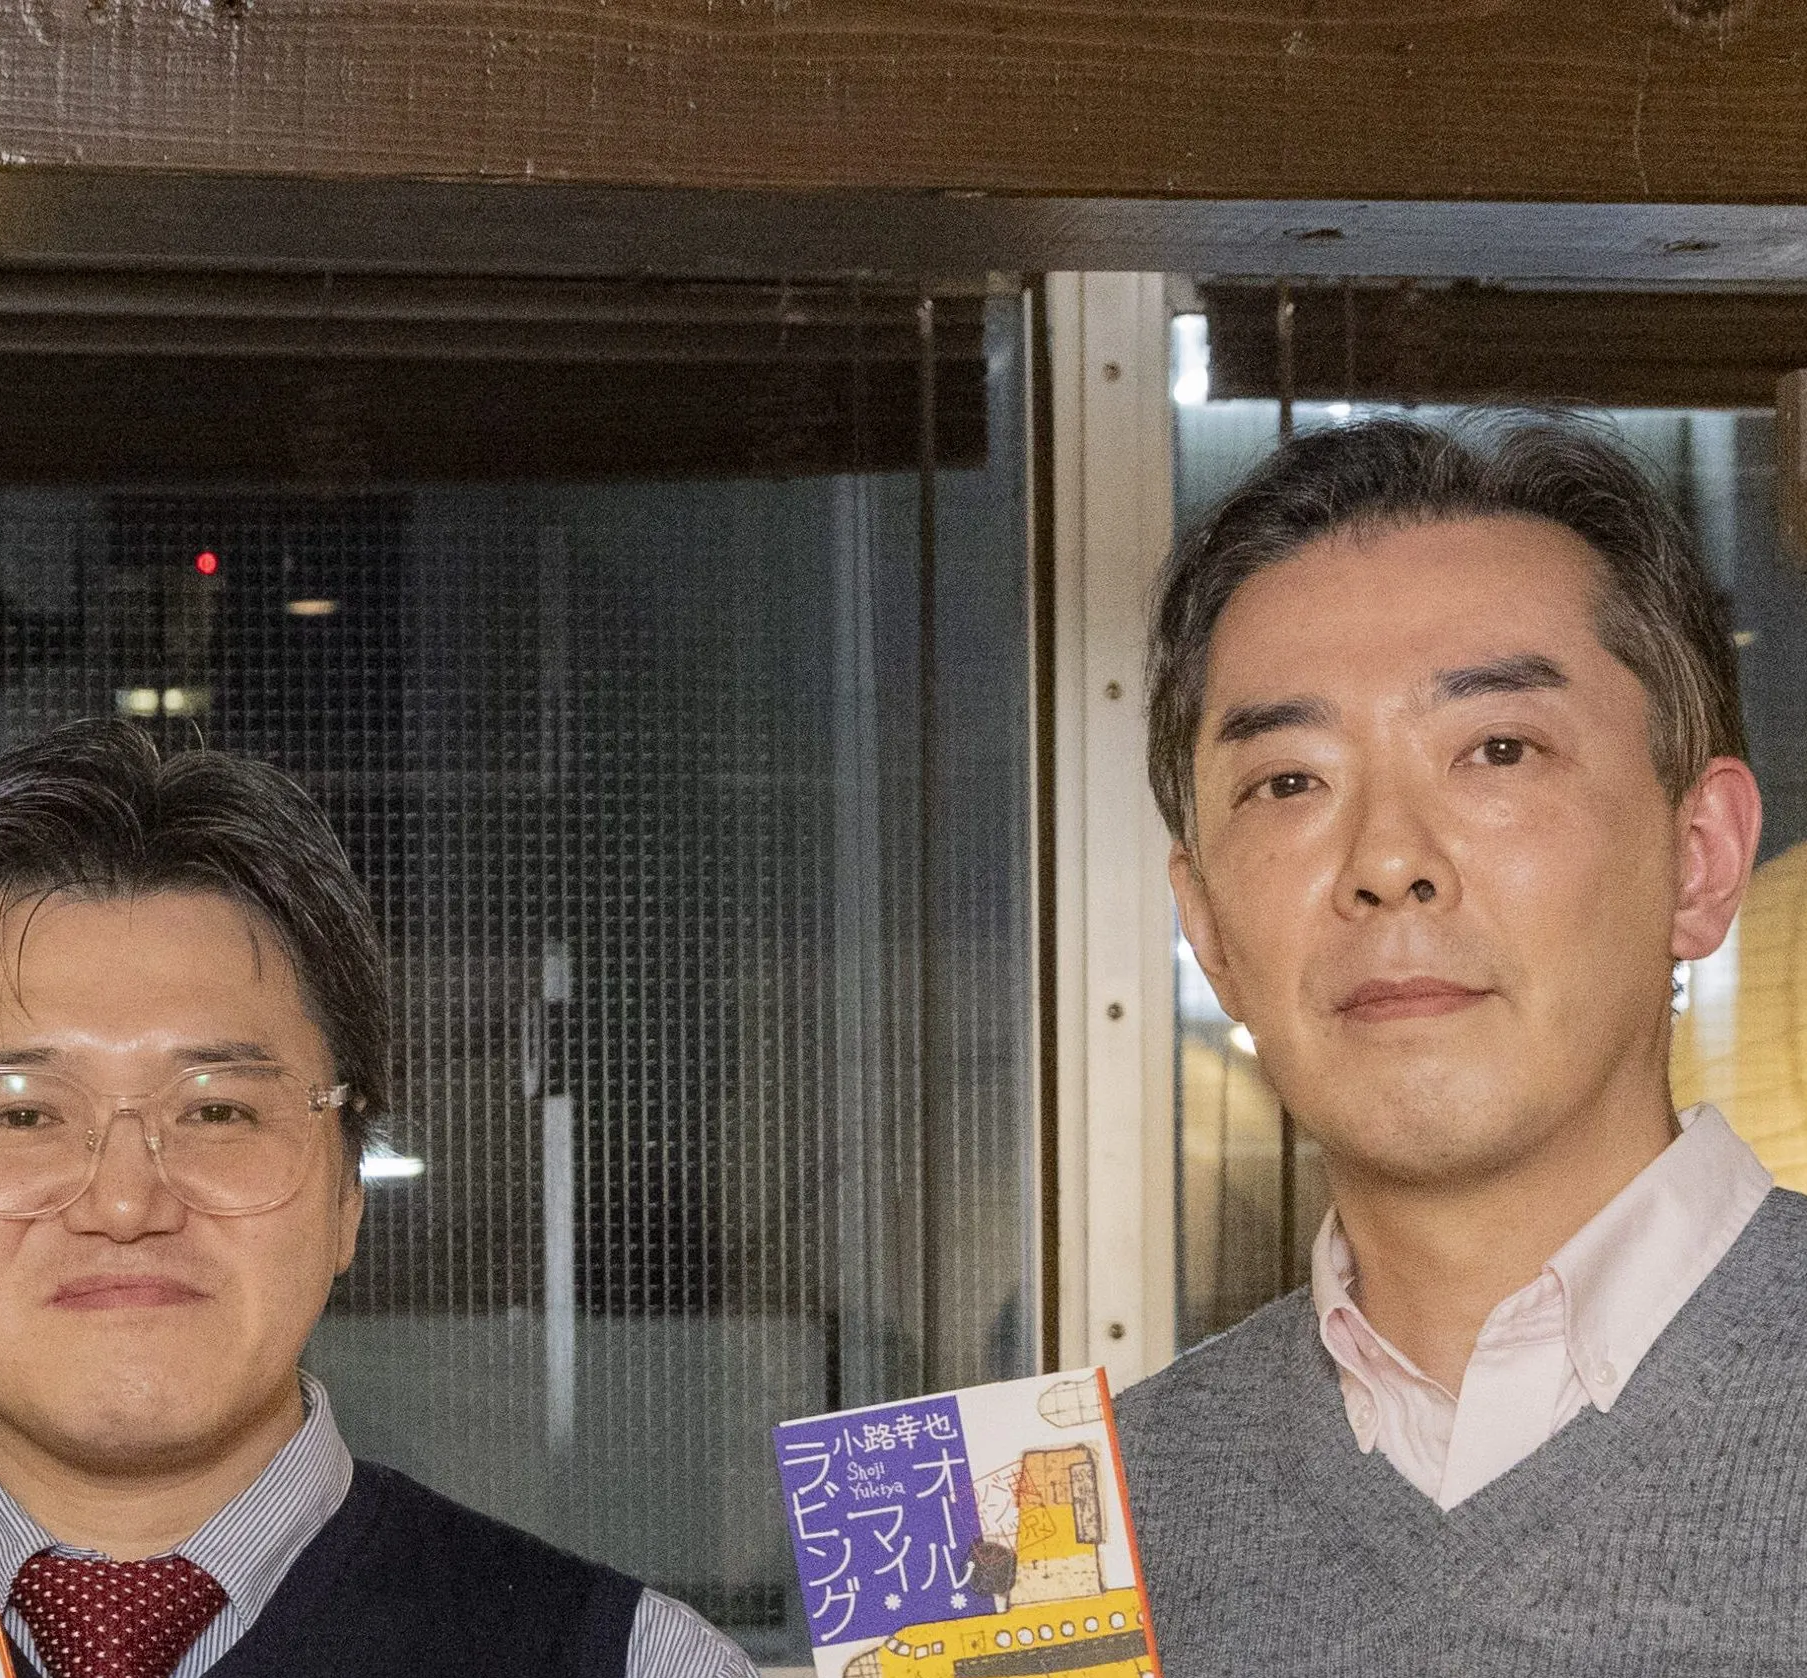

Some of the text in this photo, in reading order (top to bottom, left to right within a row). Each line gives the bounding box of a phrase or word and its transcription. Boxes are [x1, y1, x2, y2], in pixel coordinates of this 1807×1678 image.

[832, 1412, 960, 1458] 小路幸也
[846, 1460, 886, 1483] Shoji
[849, 1481, 906, 1502] Yukiya
[782, 1441, 862, 1642] ラビング
